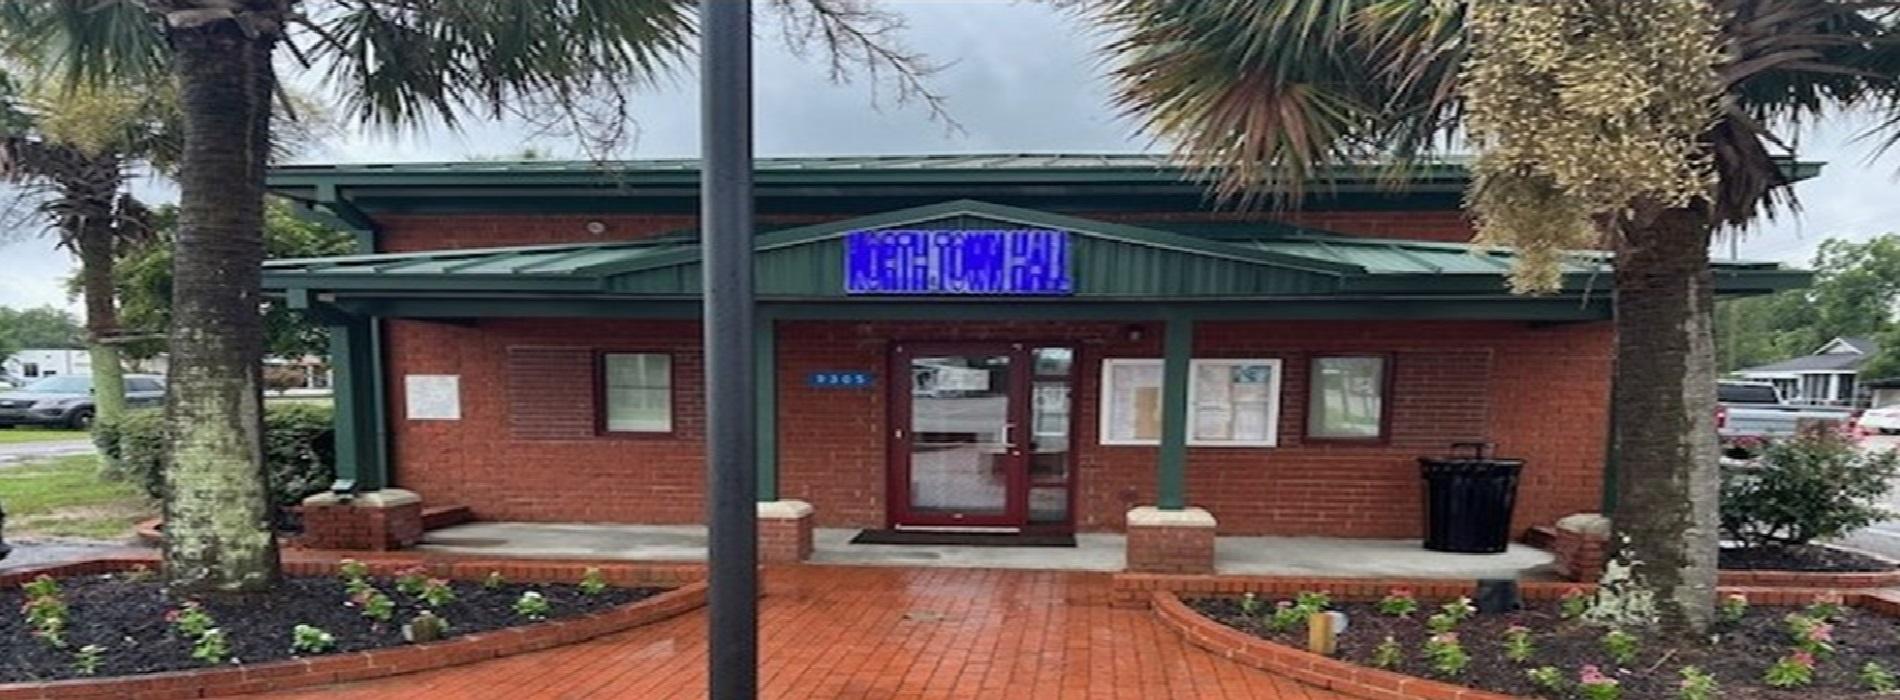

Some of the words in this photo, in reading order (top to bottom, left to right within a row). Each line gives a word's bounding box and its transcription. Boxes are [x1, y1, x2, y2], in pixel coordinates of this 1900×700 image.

[846, 230, 929, 293] NORTH
[934, 230, 1004, 293] TOWN
[1006, 230, 1073, 293] HALL
